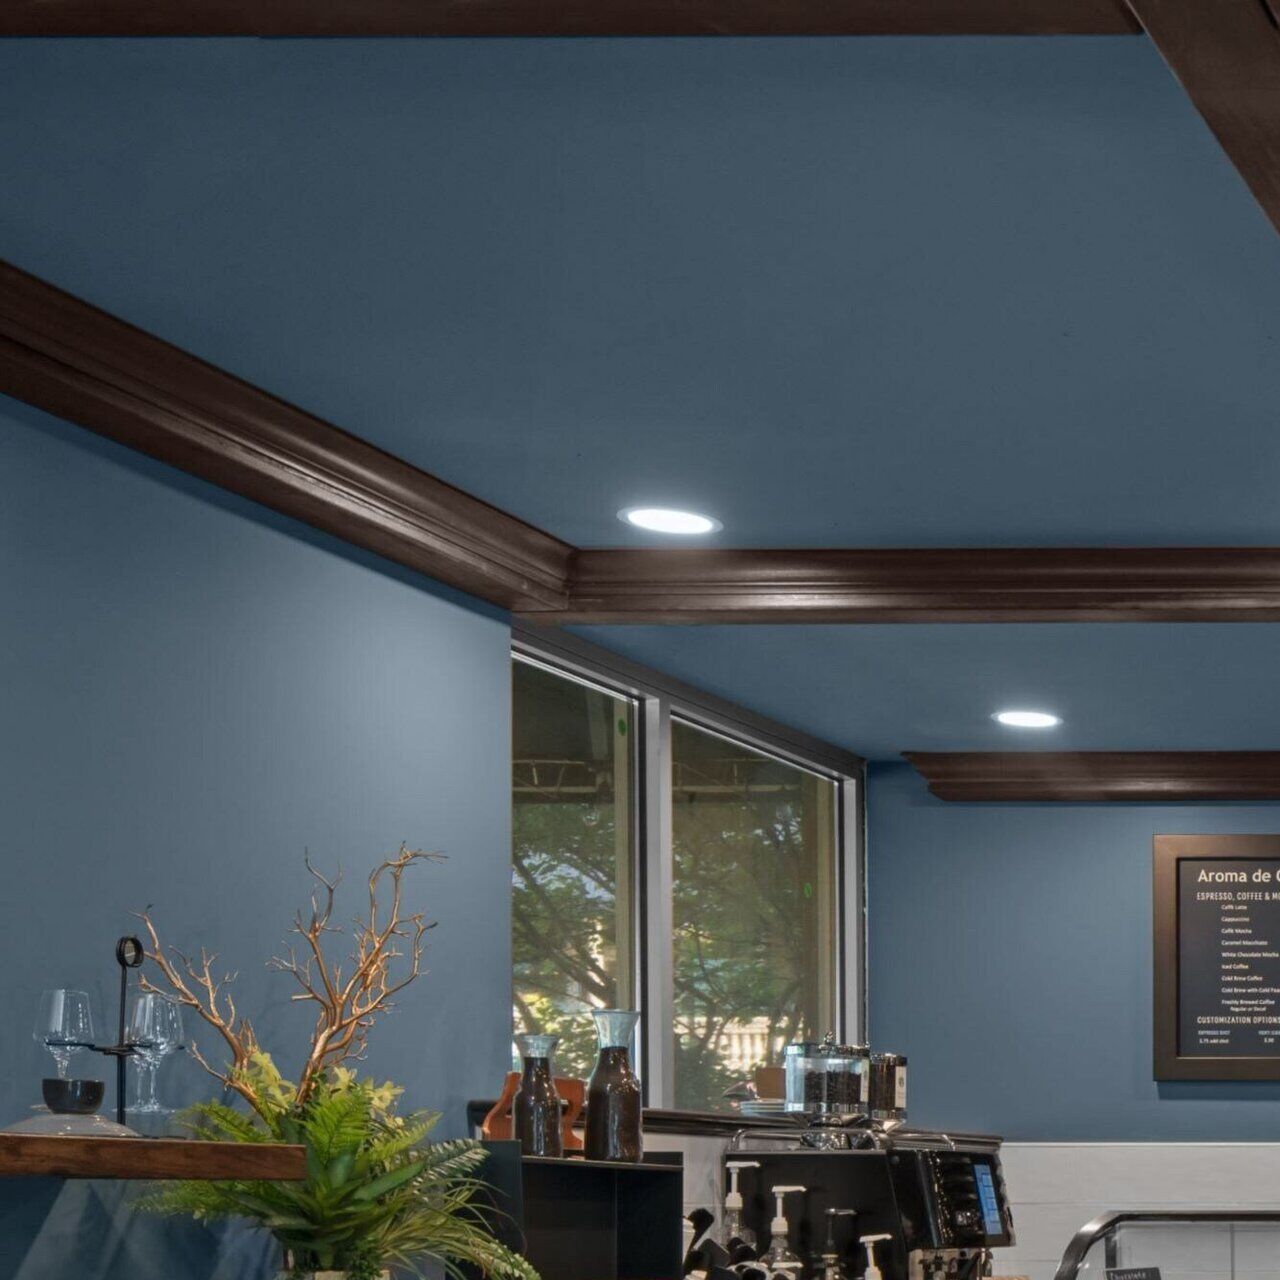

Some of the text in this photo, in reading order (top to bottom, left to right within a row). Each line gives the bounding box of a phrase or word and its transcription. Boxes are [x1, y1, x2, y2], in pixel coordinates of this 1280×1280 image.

[1197, 869, 1248, 883] Aroma
[1252, 868, 1272, 883] de
[1236, 892, 1262, 901] COFFEE
[1264, 892, 1270, 901] &
[1197, 1016, 1252, 1024] CUSTOMIZATION
